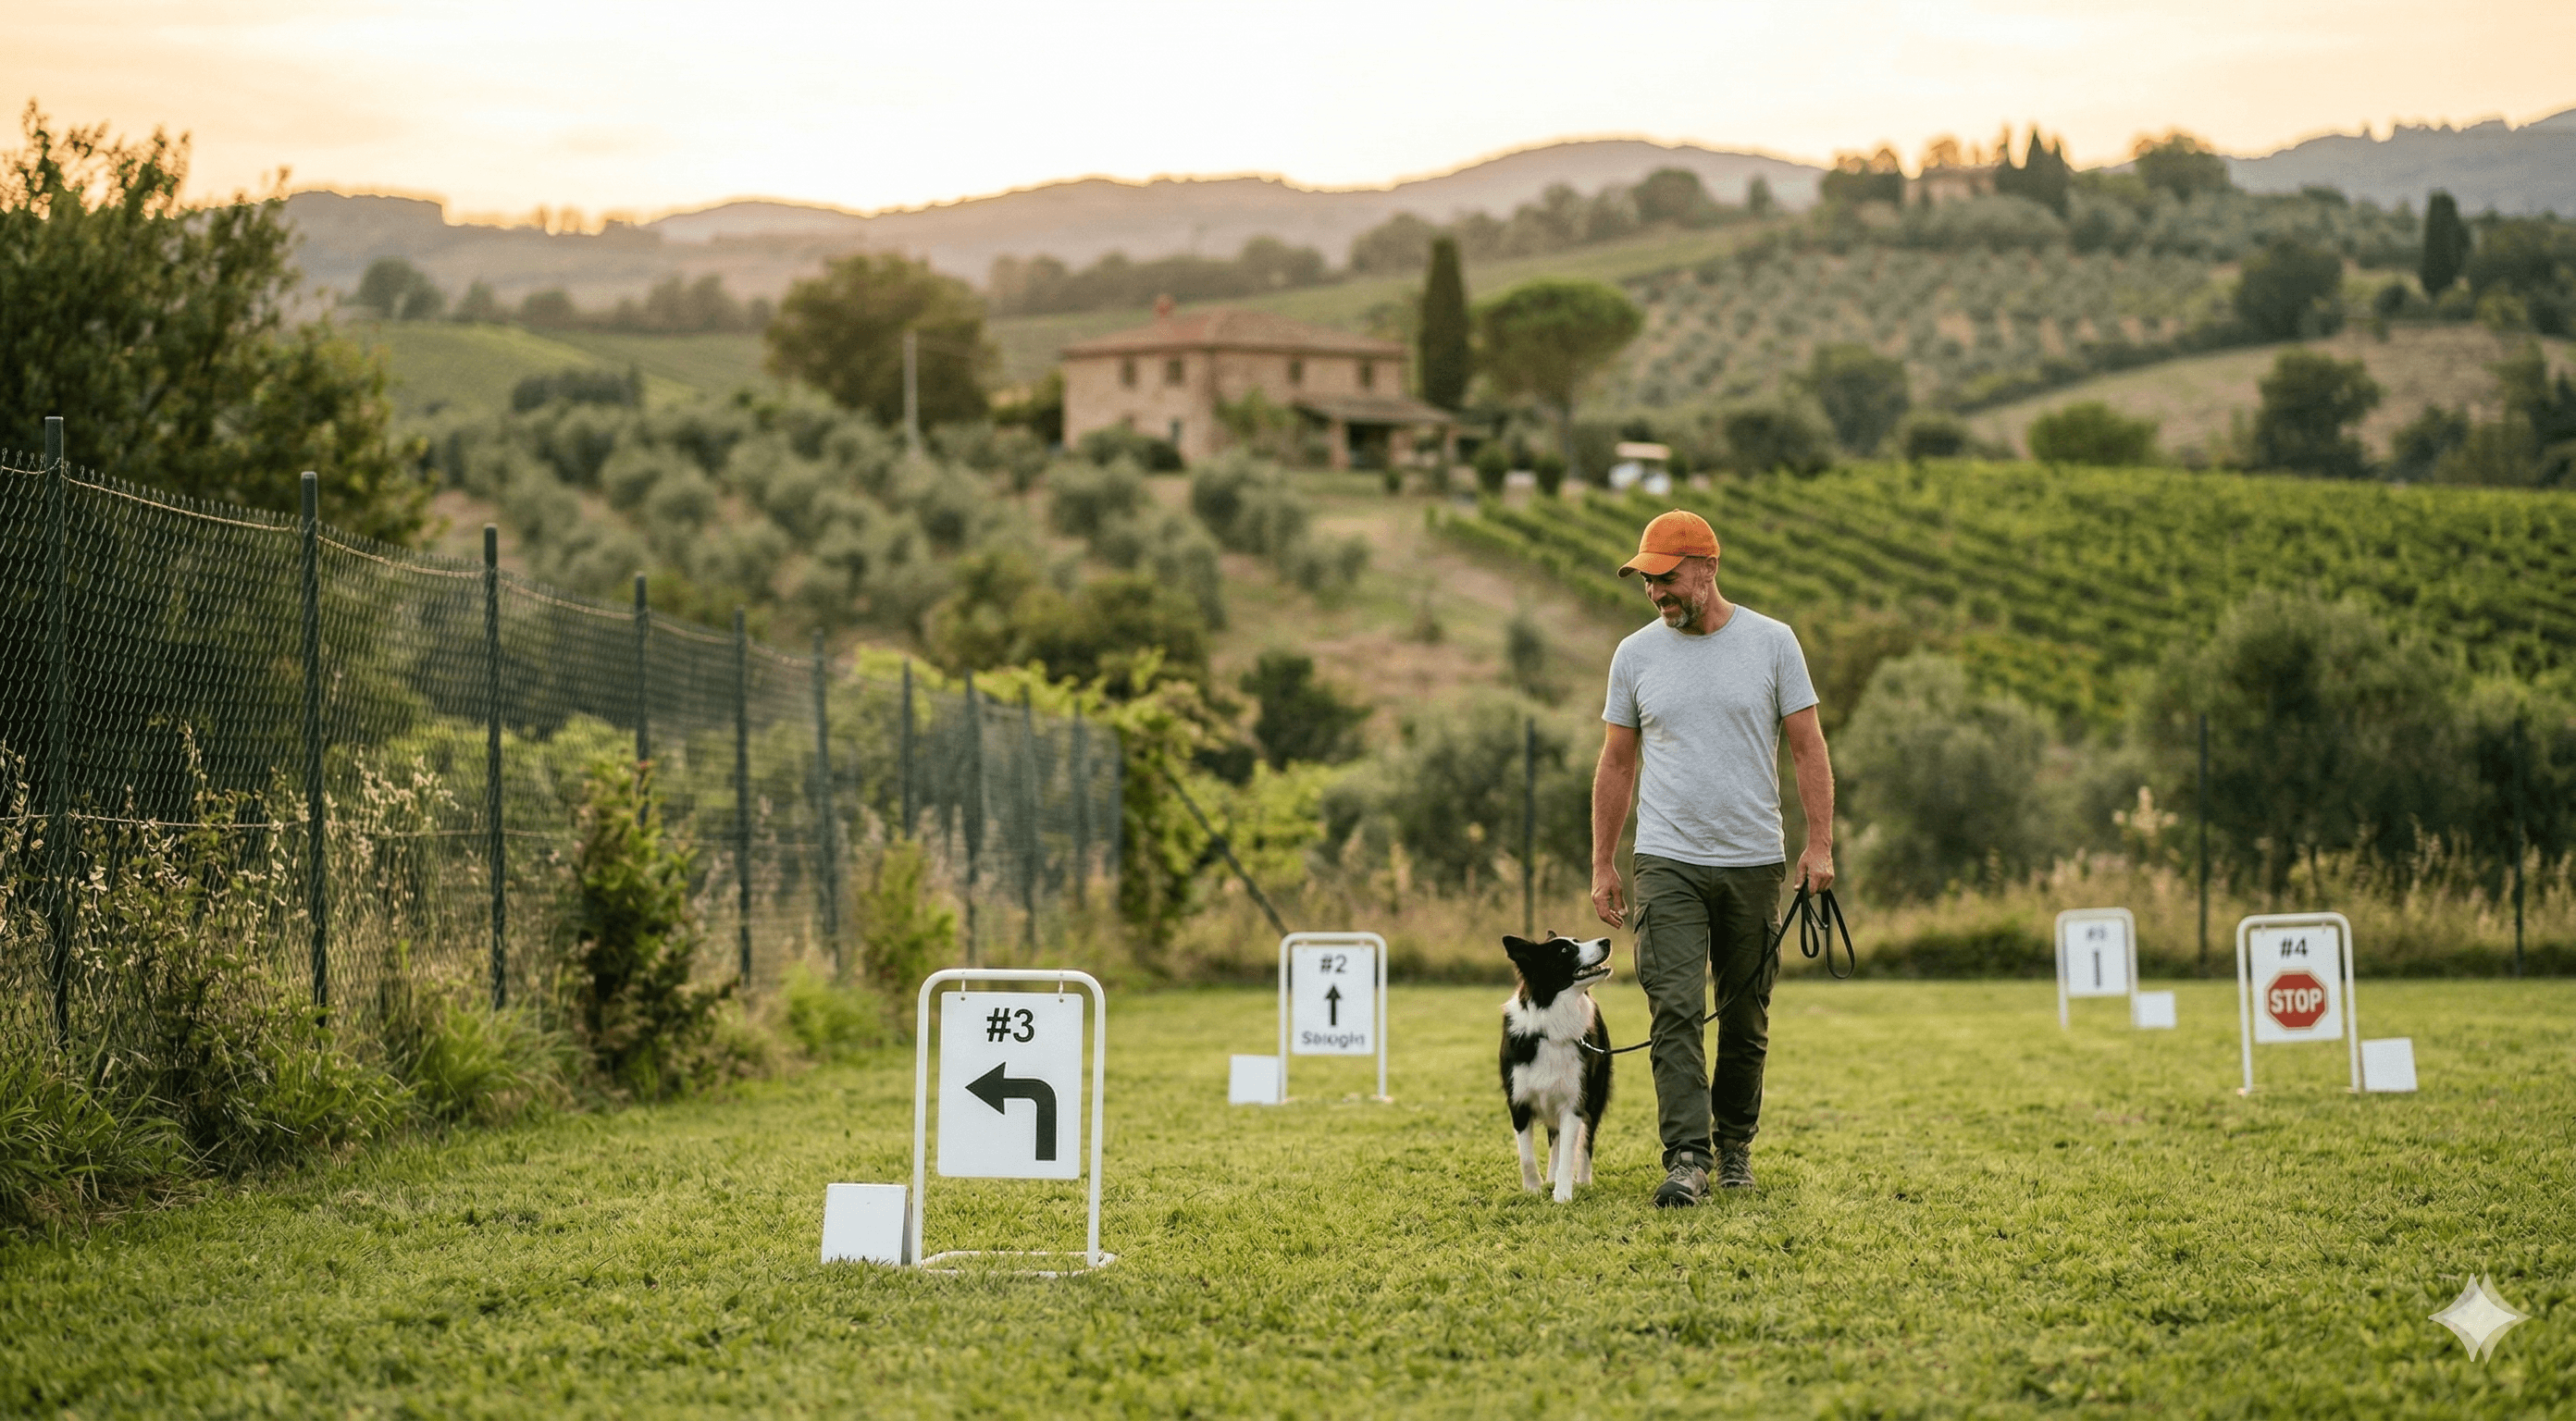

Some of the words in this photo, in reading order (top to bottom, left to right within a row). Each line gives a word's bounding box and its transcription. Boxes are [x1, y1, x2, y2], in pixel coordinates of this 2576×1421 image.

[2280, 936, 2309, 958] #4
[1319, 954, 1347, 974] #2
[2270, 988, 2323, 1014] STOP
[986, 1007, 1035, 1043] #3
